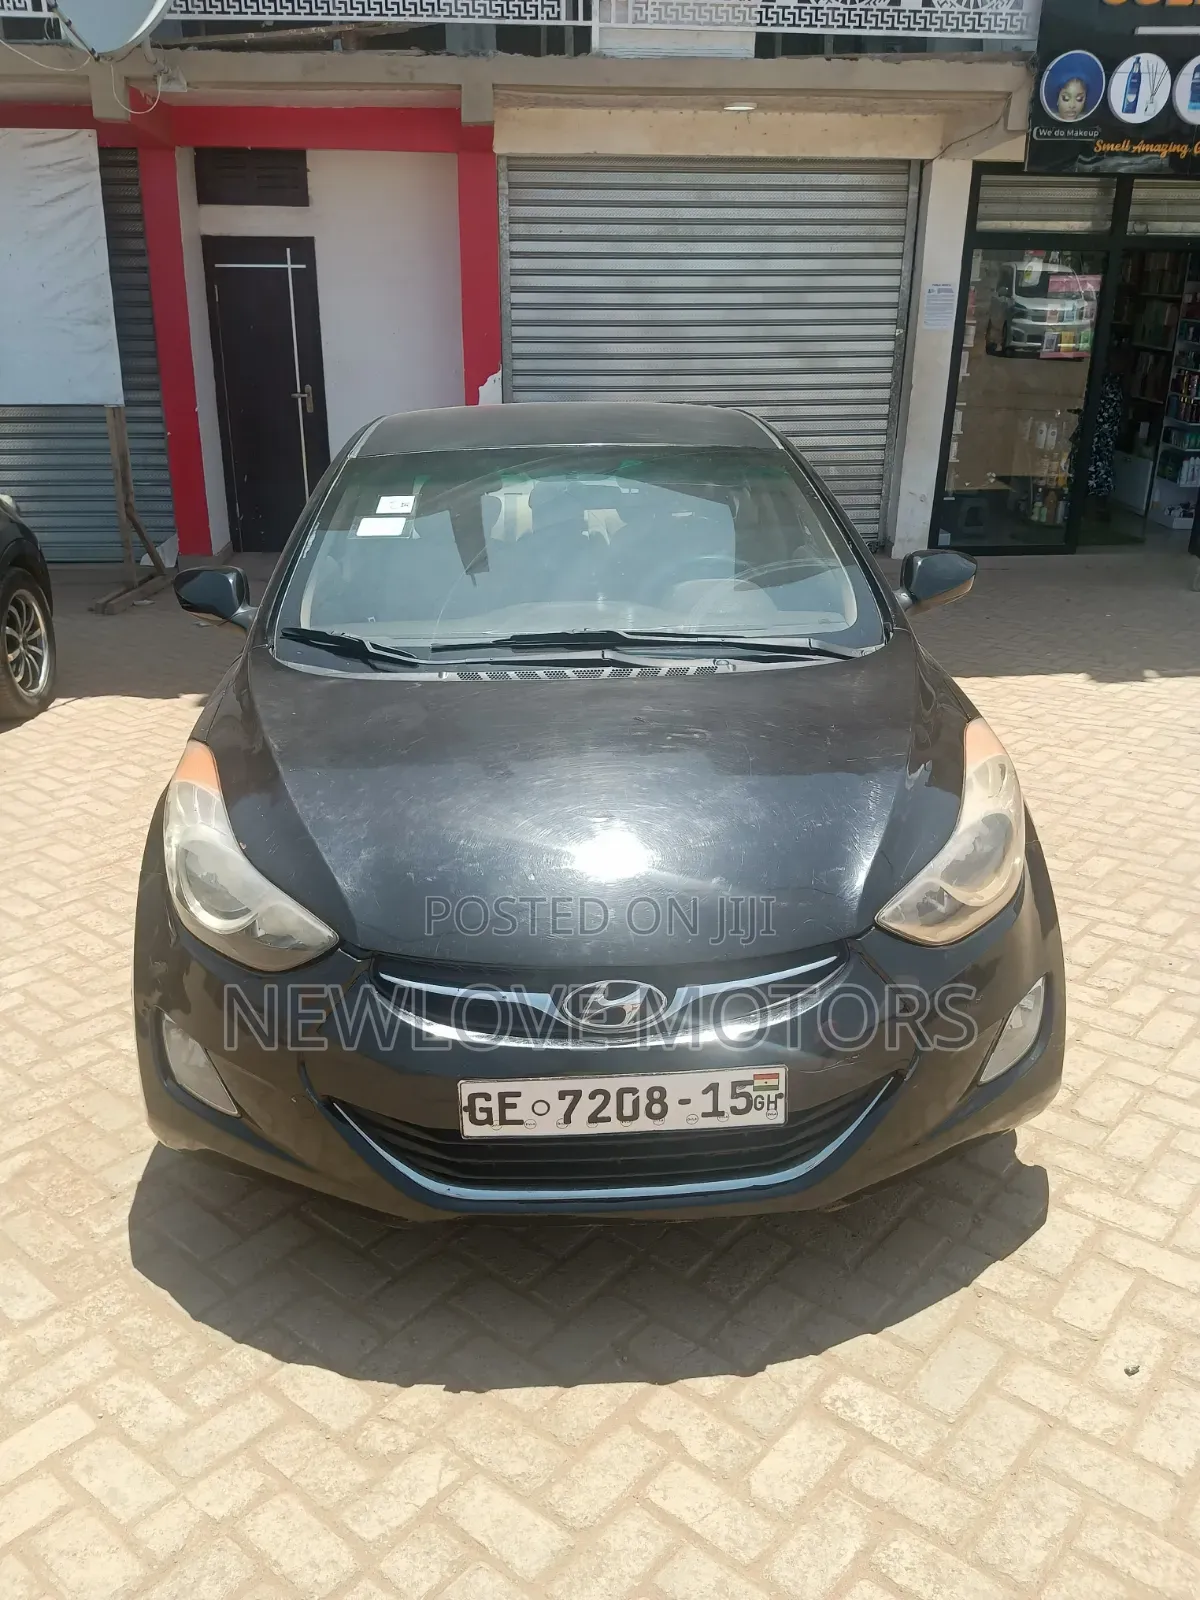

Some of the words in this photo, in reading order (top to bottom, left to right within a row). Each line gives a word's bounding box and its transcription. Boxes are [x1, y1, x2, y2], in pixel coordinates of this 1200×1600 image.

[1038, 128, 1052, 136] We
[1054, 128, 1065, 136] do
[1066, 128, 1099, 138] Makeup
[1093, 139, 1131, 153] Smell
[1133, 139, 1189, 159] Amazing
[467, 1091, 524, 1126] GE
[754, 1093, 778, 1111] GH
